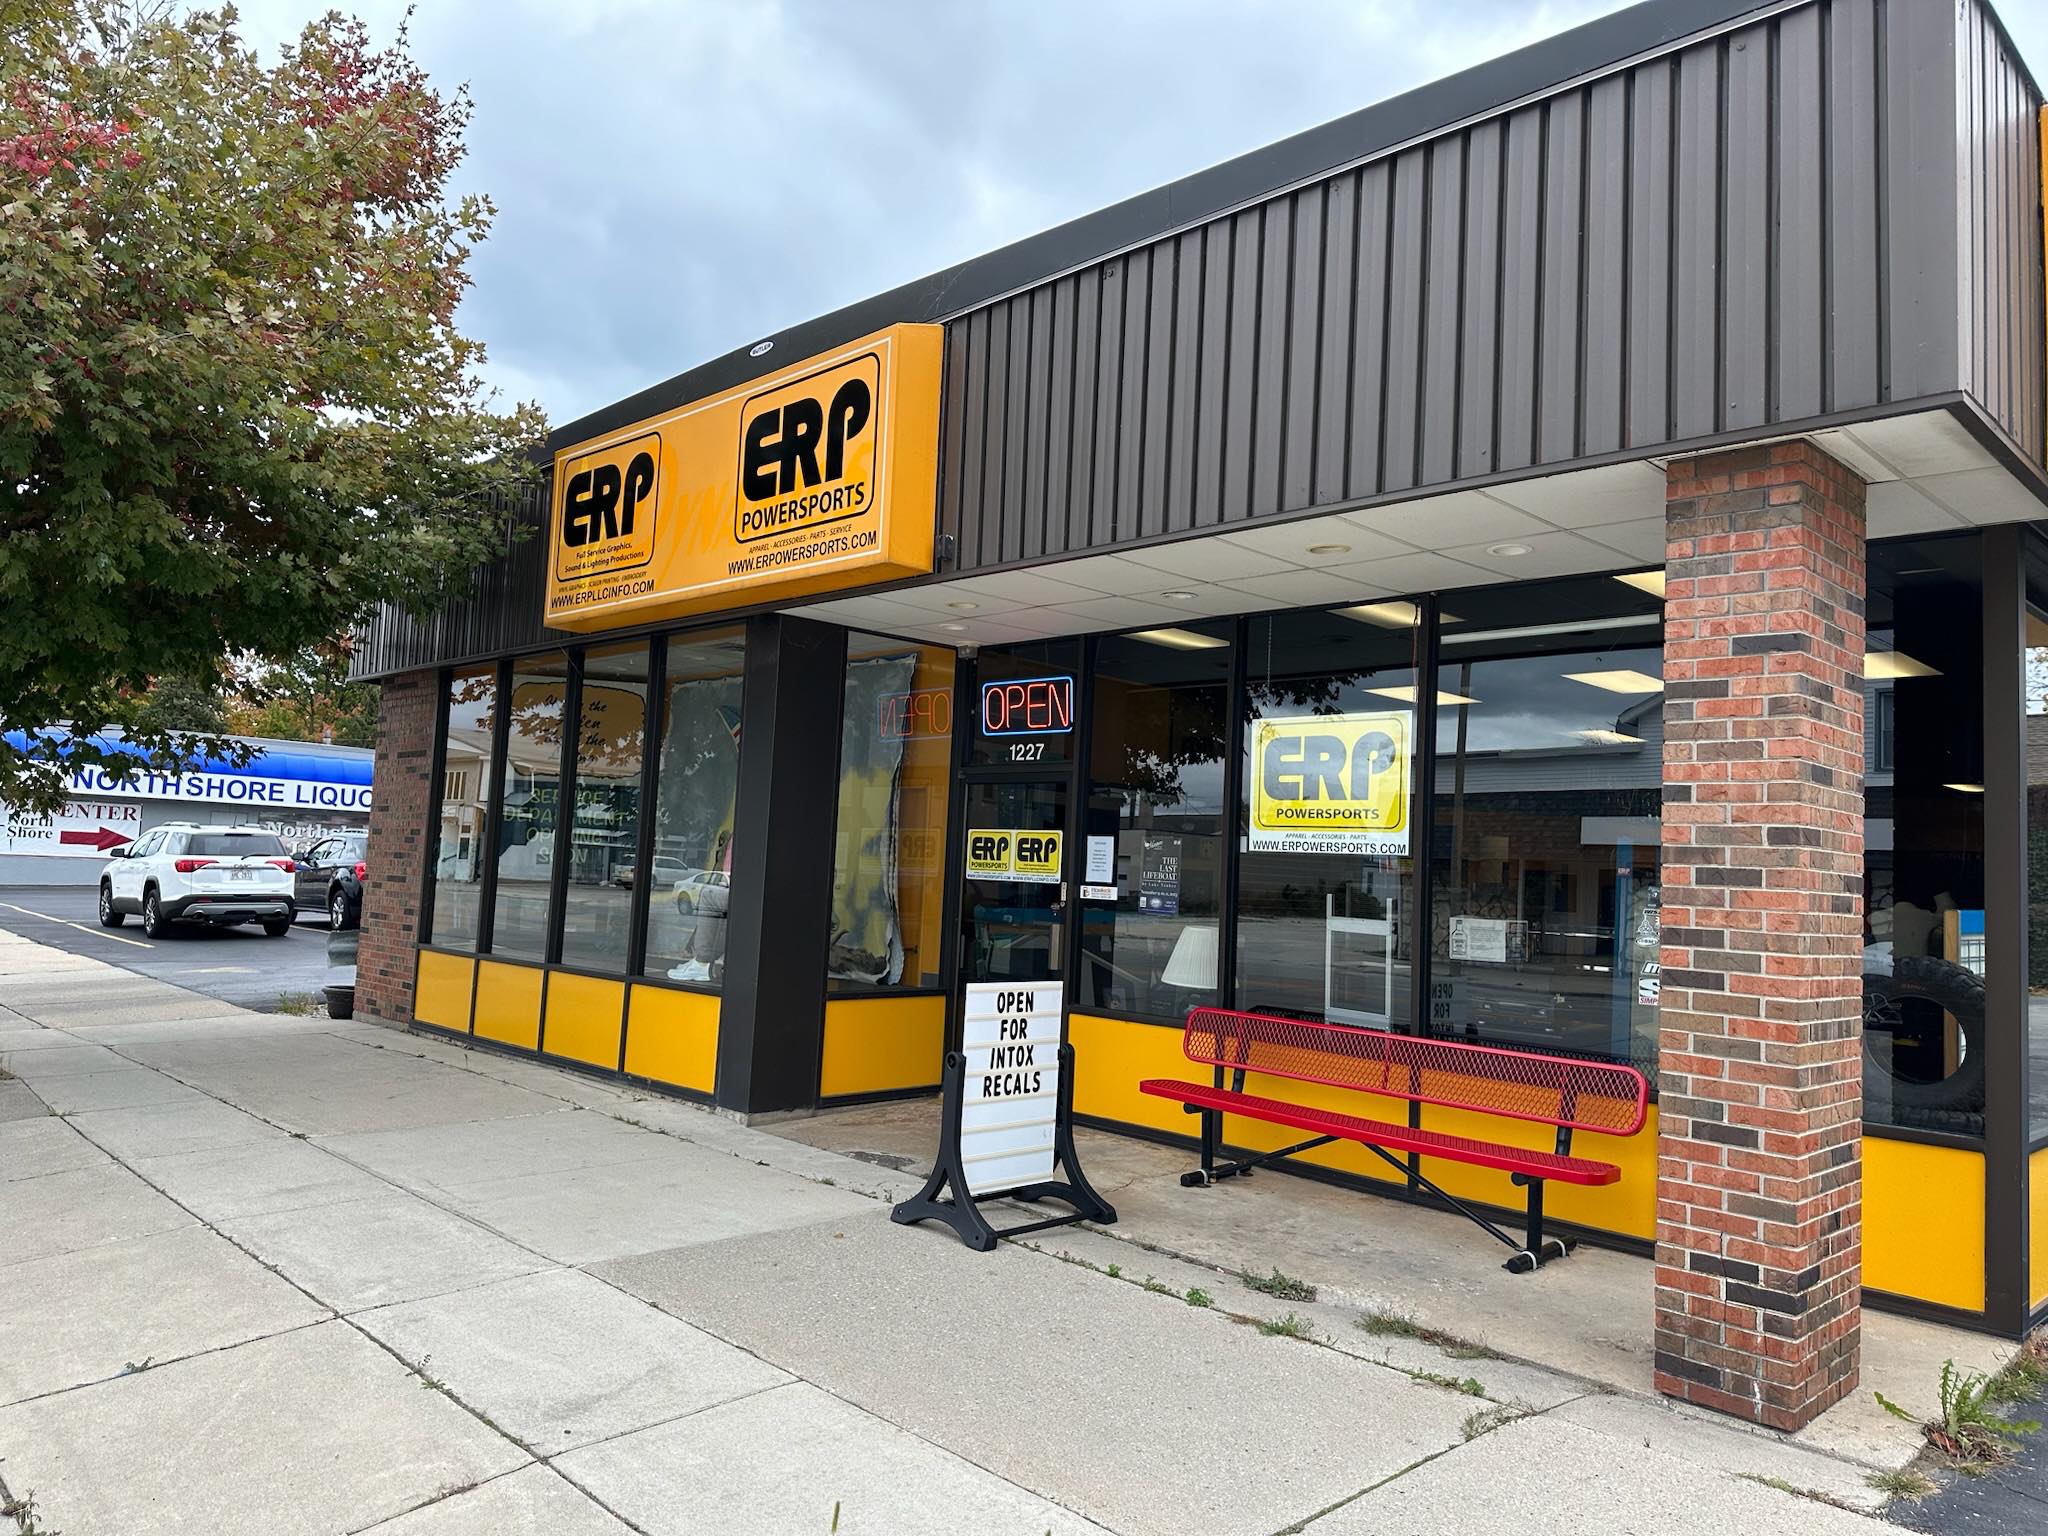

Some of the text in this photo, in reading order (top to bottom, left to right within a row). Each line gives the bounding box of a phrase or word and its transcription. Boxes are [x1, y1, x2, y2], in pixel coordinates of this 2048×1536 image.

[743, 378, 871, 502] ERP
[563, 452, 655, 547] ERP
[741, 482, 865, 533] POWERSPORTS
[749, 524, 852, 554] APPAREL ACCESSORIES PARTS SERVICE
[564, 562, 581, 573] Sound
[587, 557, 610, 568] Lighting
[610, 551, 644, 563] Productions
[576, 550, 586, 560] Full
[587, 547, 607, 558] Service
[728, 530, 877, 575] WWW.ERPOWERSPORTS.COM
[551, 579, 655, 609] WWW.ERPLLCINFO.COM
[986, 682, 1069, 730] OPEN
[1009, 743, 1045, 761] 1227
[1263, 731, 1396, 801] ERP
[503, 806, 625, 827] DEPAMENT
[1276, 808, 1380, 820] POWERSPORTS
[7, 825, 53, 840] Shore
[972, 836, 1009, 861] ERP
[1018, 837, 1057, 863] ERP
[1252, 840, 1407, 854] WWW.ERPOWERSPORTS.COM
[971, 861, 1008, 869] POWERSPORTS
[1159, 864, 1177, 872] LAST
[1162, 857, 1178, 865] THE
[1143, 871, 1178, 880] LIFEBOAT
[996, 991, 1034, 1014] OPEN
[1000, 1018, 1028, 1041] FOR
[990, 1045, 1034, 1070] INTOX
[983, 1071, 1040, 1098] RECALS
